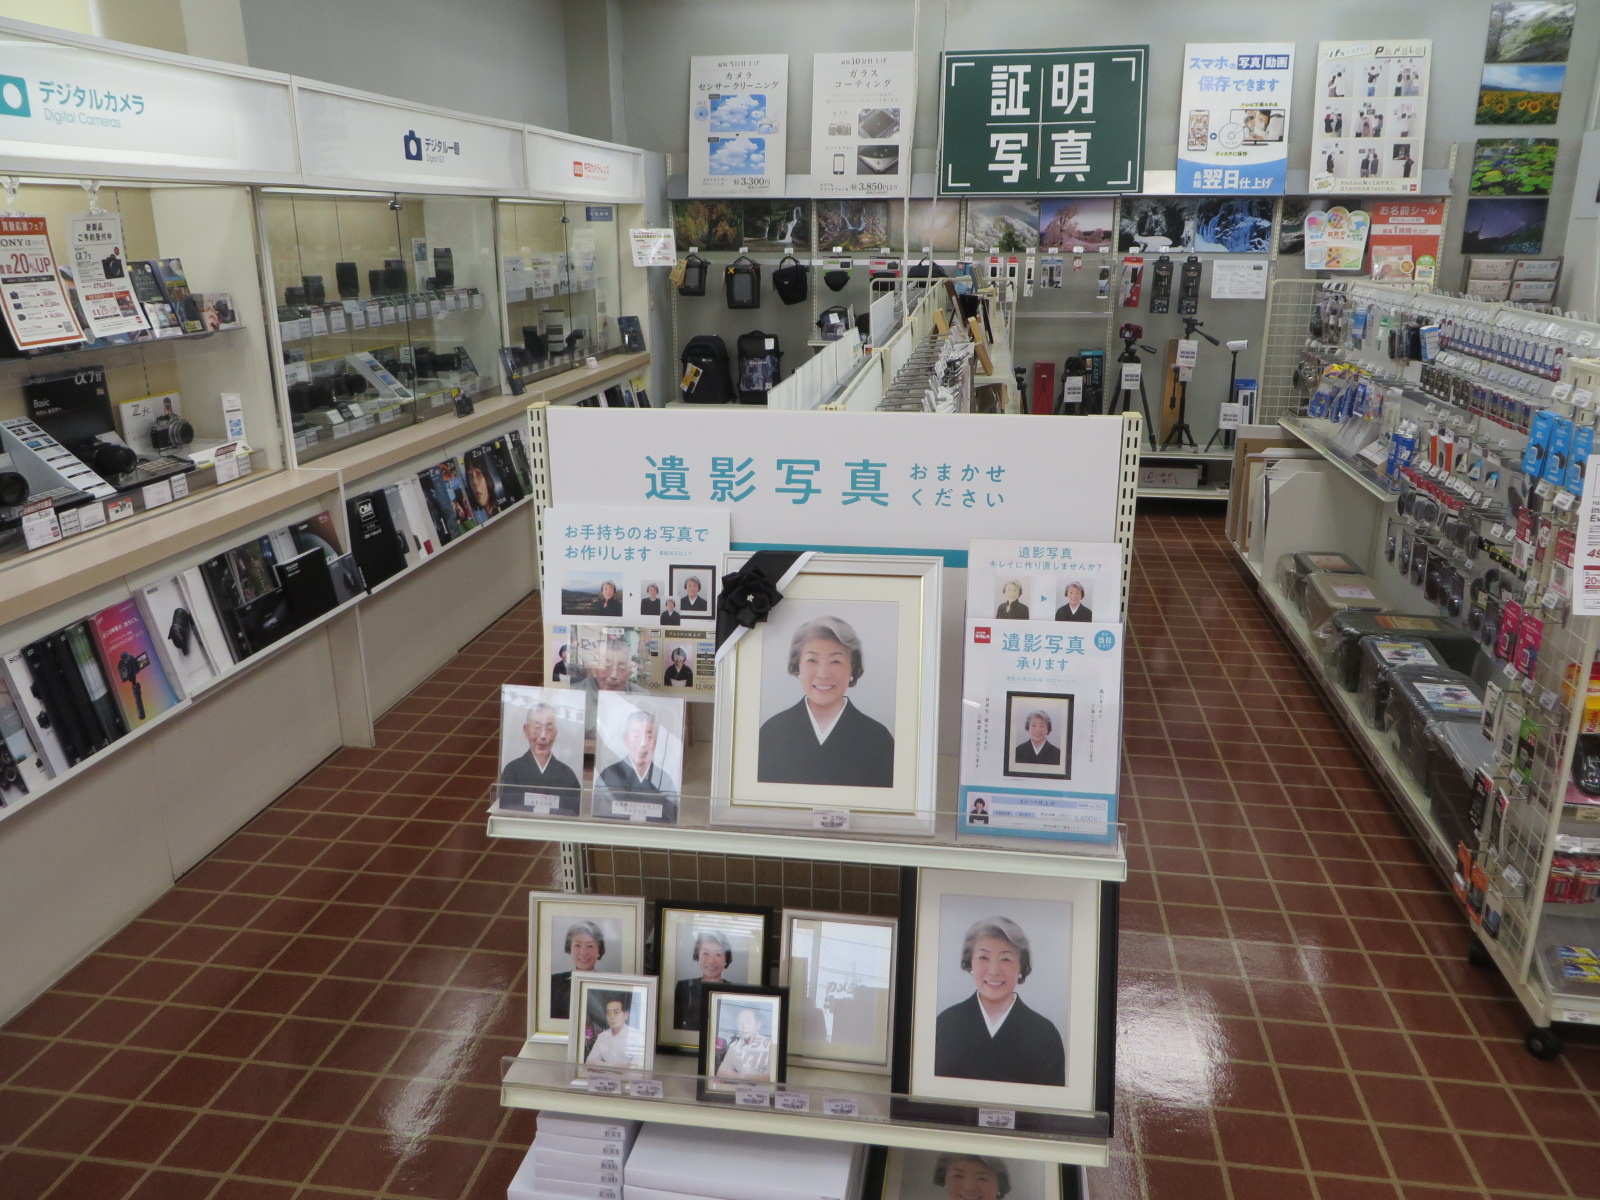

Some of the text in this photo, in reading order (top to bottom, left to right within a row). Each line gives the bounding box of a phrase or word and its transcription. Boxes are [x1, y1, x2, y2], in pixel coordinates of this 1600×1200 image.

[726, 72, 752, 80] カメラ
[850, 69, 878, 78] ガラス
[698, 81, 779, 91] センサークリーニング
[834, 79, 892, 89] コーティング
[991, 62, 1095, 117] 証明
[1198, 75, 1280, 93] 保存できます
[39, 81, 145, 115] デジタルカメラ
[44, 107, 121, 128] Digital Cameras
[425, 138, 460, 156] デジタル一眼
[988, 130, 1092, 183] 写真
[1380, 206, 1438, 216] お名前シール
[0, 239, 23, 247] ONY
[33, 399, 50, 408] Basic
[645, 455, 1006, 507] 遺影写真 おまかせ
[909, 489, 1006, 508] ください
[360, 503, 374, 514] OM
[565, 524, 709, 542] お手持ちのお写真で
[565, 545, 651, 562] お作りします
[1018, 547, 1073, 559] 遺影写真
[989, 560, 1102, 571] キレイに作り直しませんか?
[1002, 633, 1085, 655] 遺影写真
[1016, 657, 1069, 671] 承ります
